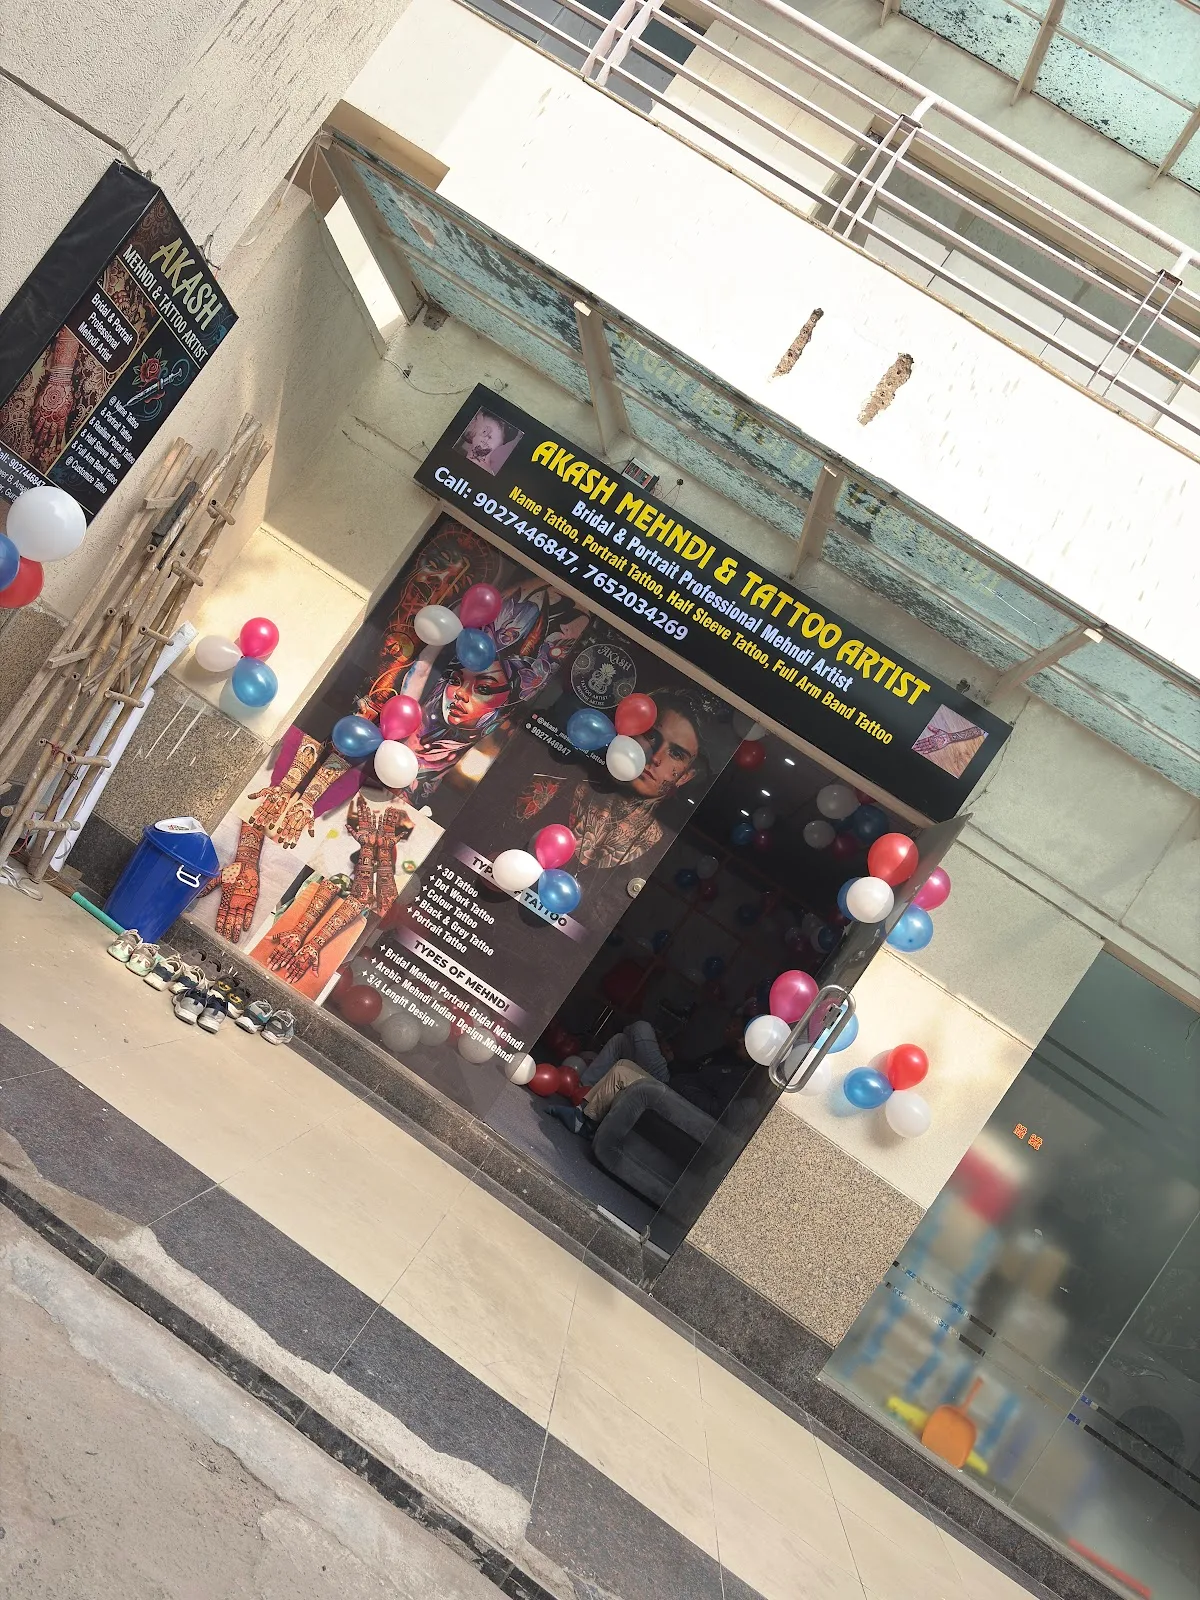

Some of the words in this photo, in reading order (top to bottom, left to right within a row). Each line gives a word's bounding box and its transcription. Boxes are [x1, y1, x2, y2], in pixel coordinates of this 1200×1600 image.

[122, 244, 158, 292] MEHNDI
[152, 286, 163, 301] &
[158, 293, 187, 334] TATTOO
[181, 330, 209, 363] ARTIST
[150, 237, 223, 331] AKASH
[88, 312, 120, 350] Professional
[91, 292, 110, 317] Bridal
[107, 312, 115, 324] &
[113, 318, 134, 345] Portrait
[78, 322, 100, 349] Mehndi
[96, 344, 112, 362] Artist
[104, 410, 121, 433] Portrait
[119, 425, 133, 442] Tattoo
[126, 412, 140, 430] Tattoo
[75, 444, 87, 457] Full
[84, 451, 95, 465] Arm
[93, 460, 106, 474] Band
[104, 467, 118, 485] Tattoo
[85, 432, 97, 446] Half
[94, 440, 109, 458] Sleeve
[108, 453, 122, 470] Tattoo
[122, 448, 136, 464] Tattoo
[71, 460, 95, 483] Customize
[94, 477, 107, 494] Tattoo
[434, 466, 472, 499] Call:
[472, 492, 580, 574] 9027446847,
[582, 564, 689, 641] 7652034269
[531, 440, 618, 505] AKASH
[615, 491, 716, 570] MEHNDI
[714, 556, 738, 586] &
[740, 571, 842, 649] TATTOO
[836, 640, 932, 706] ARTIST
[508, 485, 542, 516] Name
[542, 507, 580, 544] Tattoo,
[581, 534, 628, 572] Portrait
[627, 563, 664, 600] Tattoo,
[666, 590, 695, 616] Half
[692, 607, 732, 641] Sleeve
[731, 632, 770, 669] Tattoo,
[772, 659, 799, 683] Full
[796, 676, 823, 700] Arm
[821, 691, 856, 720] Band
[854, 711, 893, 745] Tattoo
[571, 500, 616, 536] Bridal
[612, 527, 628, 546] &
[626, 536, 680, 580] Portrait
[677, 570, 764, 634] Professional
[759, 624, 816, 667] Mehndi
[811, 657, 854, 693] Artist
[597, 646, 632, 671] AKASH
[531, 726, 571, 756] 9027446847
[442, 867, 455, 882] 3D
[454, 875, 479, 898] Tattoo
[472, 856, 494, 879] TYP
[427, 888, 453, 913] Colour
[453, 906, 478, 929] Tattoo
[434, 878, 449, 893] Dot
[449, 887, 472, 910] Work
[470, 902, 495, 925] Tattoo
[411, 909, 443, 936] Portrait
[442, 931, 467, 954] Tattoo
[419, 900, 442, 920] Black
[441, 915, 451, 926] &
[450, 921, 469, 940] Grey
[469, 933, 494, 956] Tattoo
[376, 961, 402, 984] Arebic
[401, 978, 432, 1005] Mehndi
[430, 999, 457, 1023] Indian
[413, 939, 449, 967] TYPES
[448, 965, 466, 981] OF
[465, 976, 510, 1012] MEHNDI
[367, 974, 381, 989] 3/4
[381, 984, 407, 1009] Lenght
[408, 1001, 435, 1028] Design
[385, 948, 409, 970] Bridal
[408, 964, 440, 991] Mehndi
[438, 985, 472, 1013] Portrait
[469, 1006, 495, 1030] Bridal
[493, 1023, 525, 1052] Mehndi
